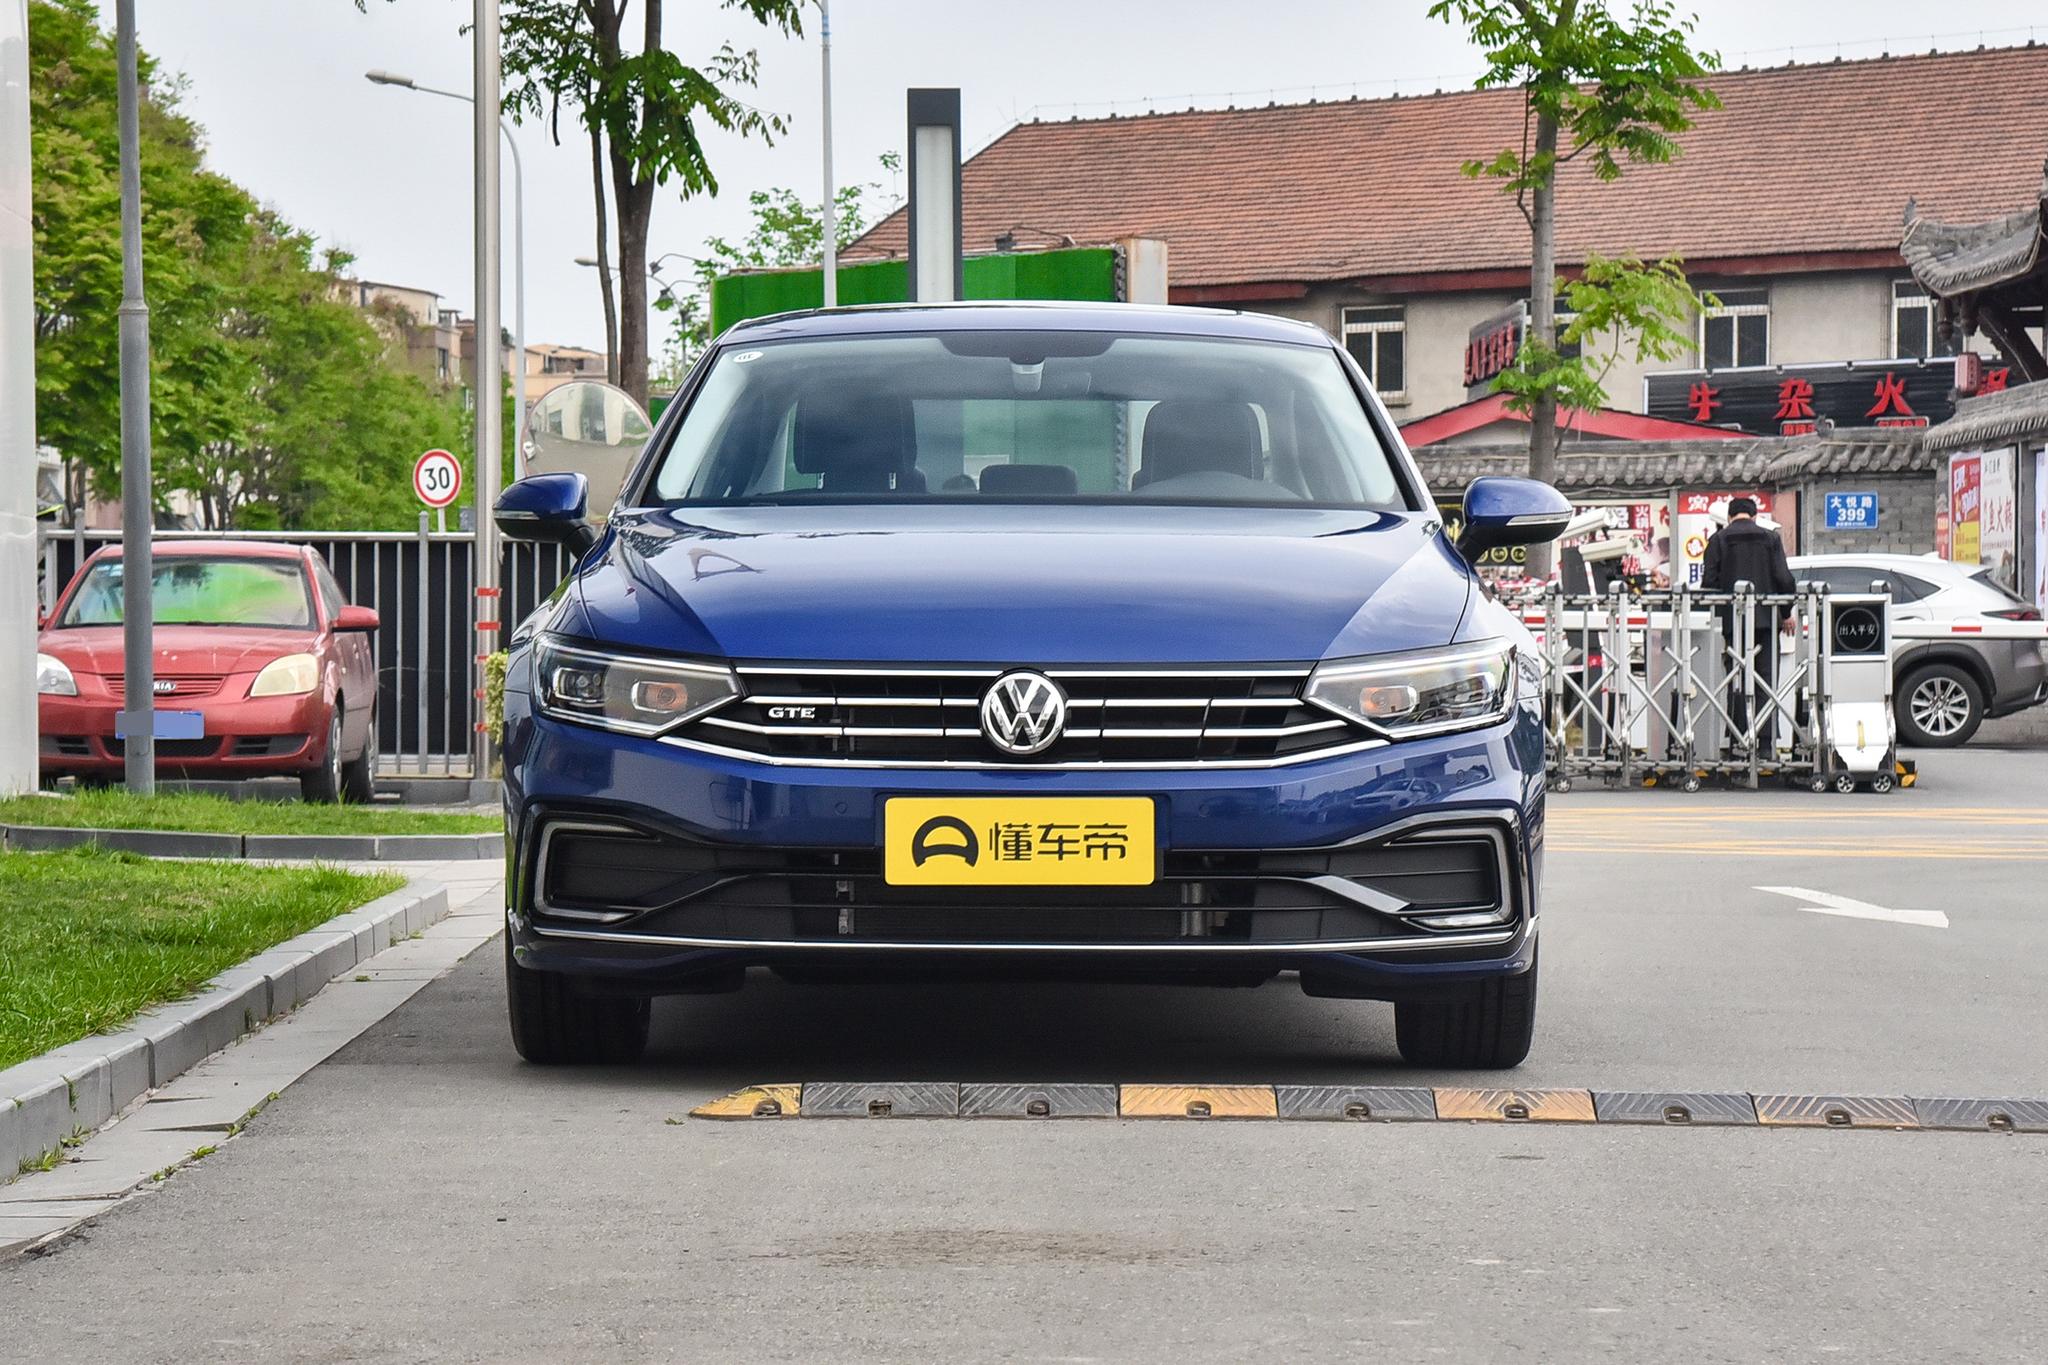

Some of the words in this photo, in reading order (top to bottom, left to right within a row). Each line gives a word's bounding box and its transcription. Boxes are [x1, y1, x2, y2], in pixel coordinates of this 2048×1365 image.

[424, 466, 450, 491] 30
[1830, 496, 1873, 508] 大悦路
[1837, 508, 1866, 521] 399
[1839, 624, 1876, 636] 出入平安
[768, 706, 816, 719] GTE
[989, 822, 1129, 861] 懂车帝
